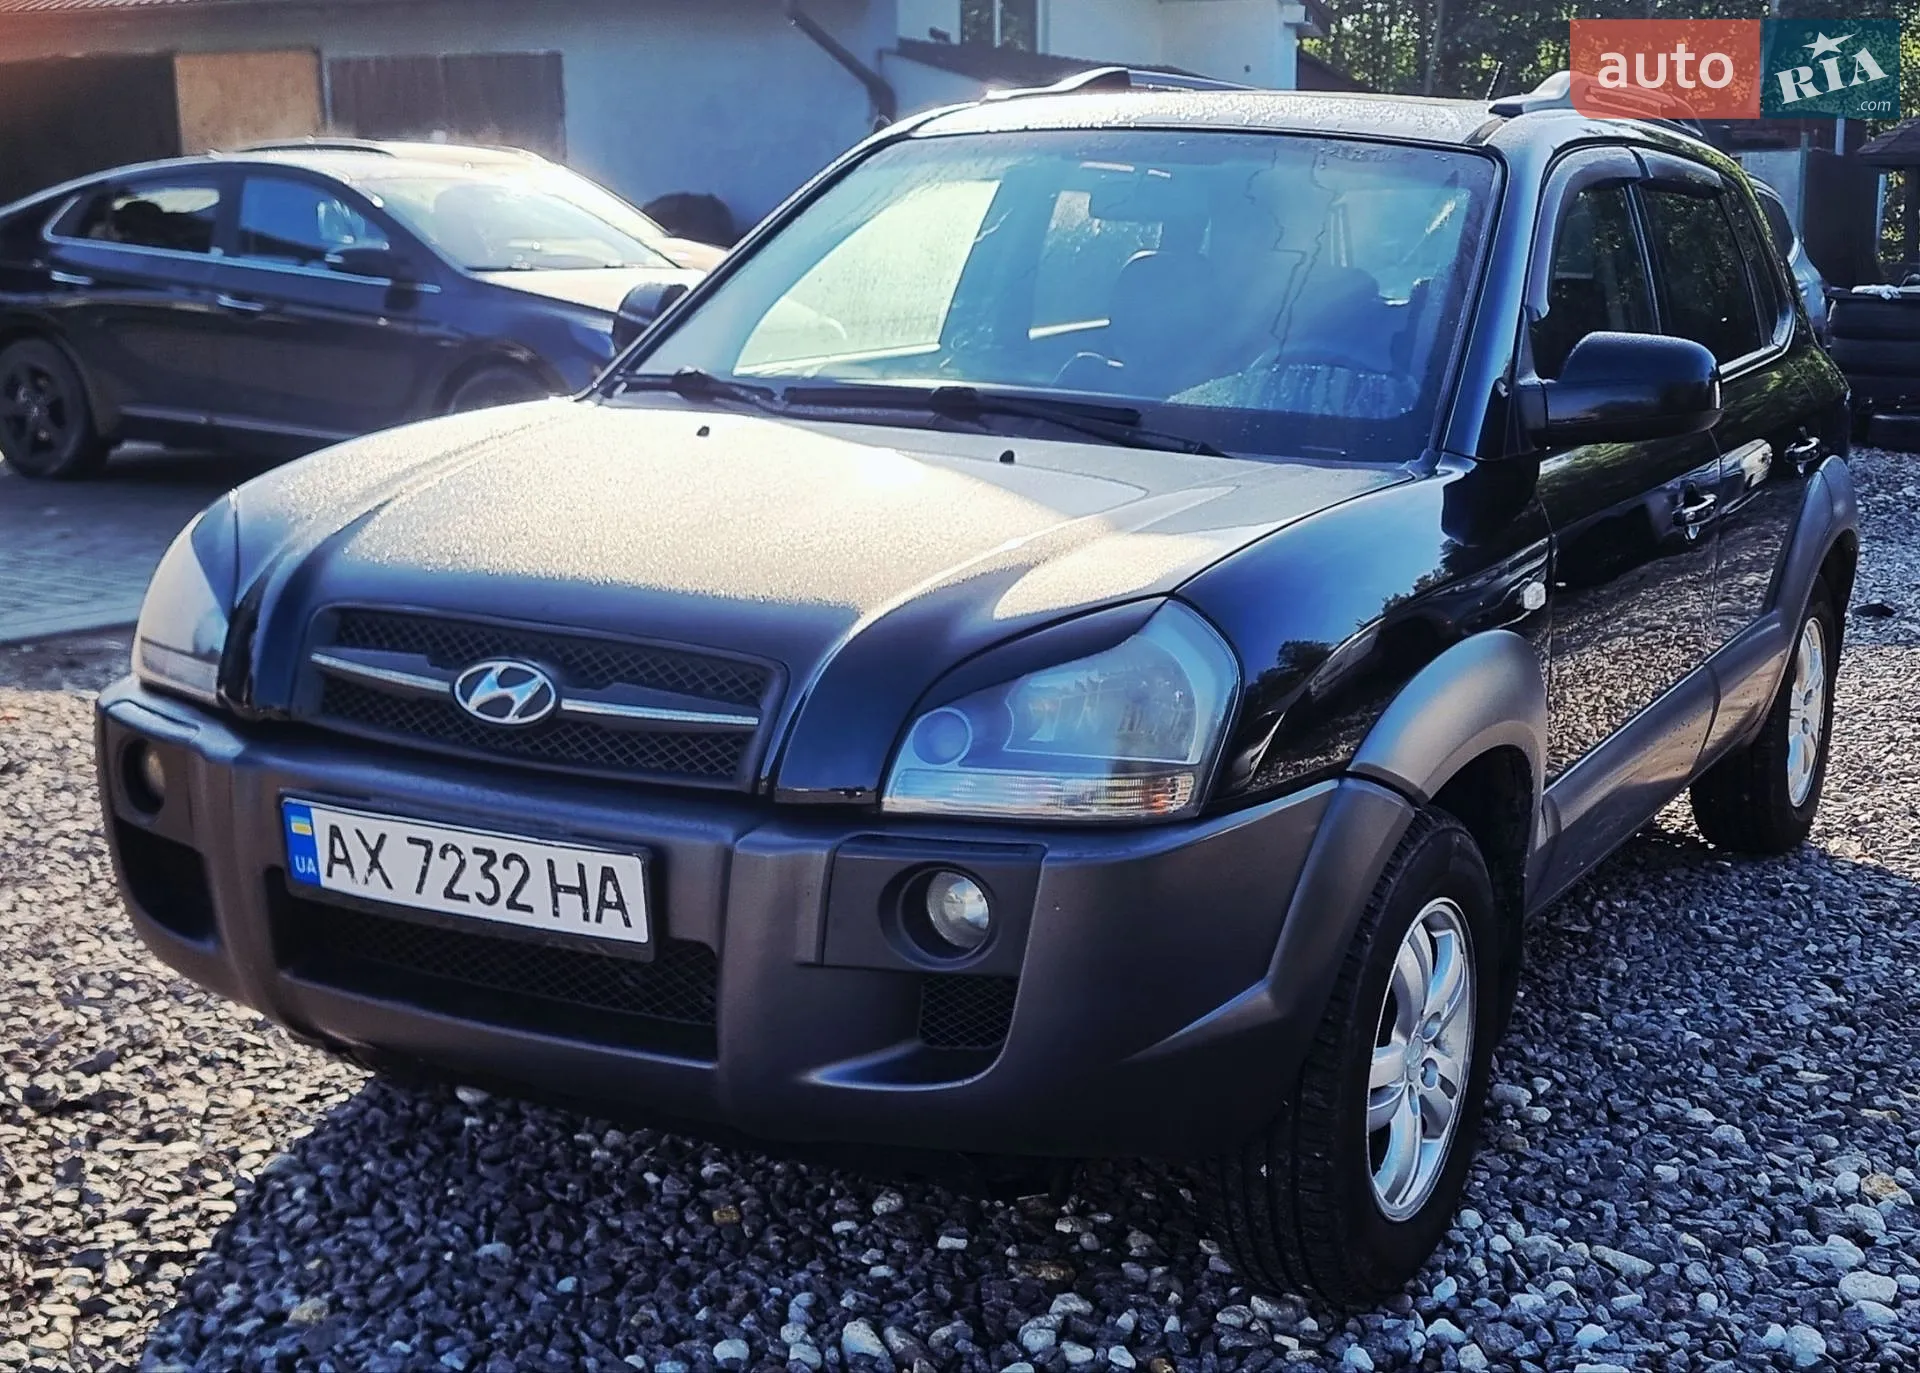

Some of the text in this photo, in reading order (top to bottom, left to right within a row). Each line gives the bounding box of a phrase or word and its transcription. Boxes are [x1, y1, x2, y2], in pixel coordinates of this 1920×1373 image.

[295, 857, 318, 876] UA
[326, 824, 633, 928] AX 7232 HA
